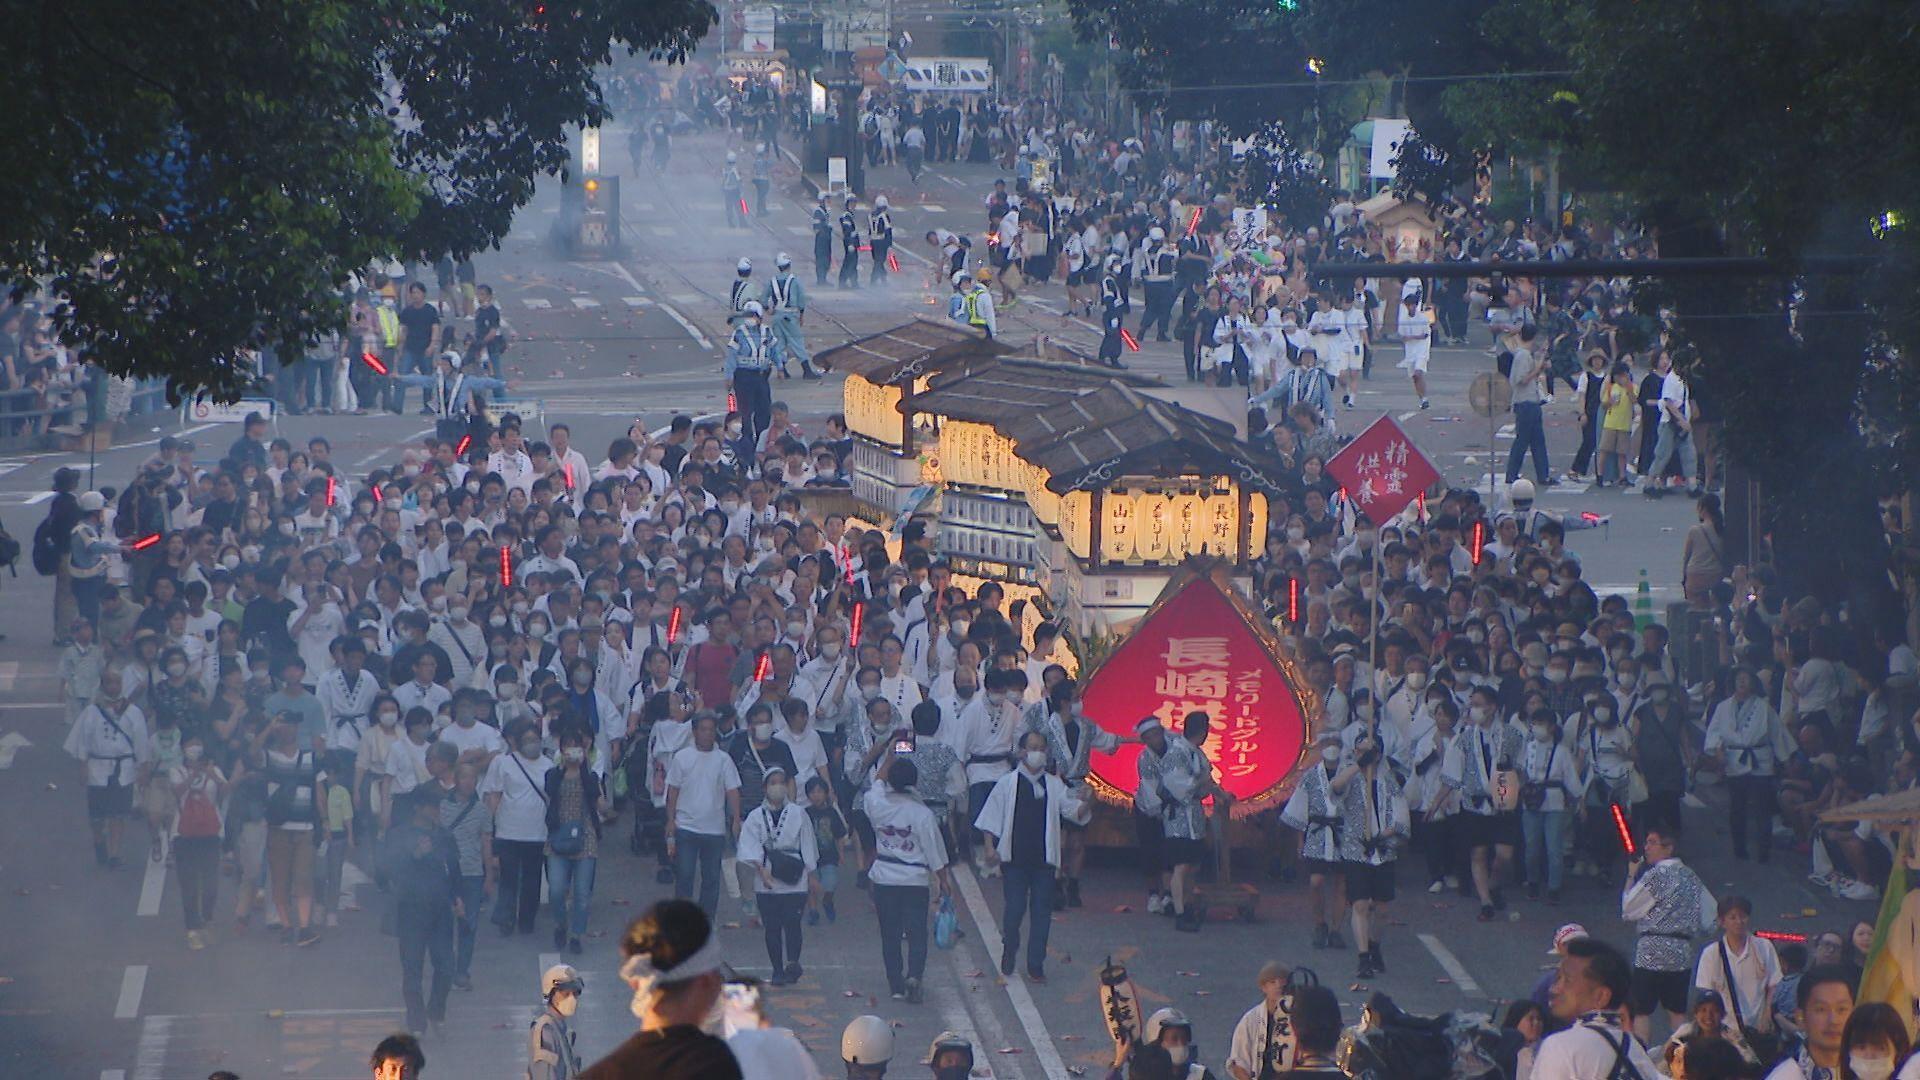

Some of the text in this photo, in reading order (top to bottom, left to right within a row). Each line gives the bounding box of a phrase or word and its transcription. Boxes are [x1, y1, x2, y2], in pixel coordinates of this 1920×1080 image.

[1355, 451, 1381, 504] 供養
[1384, 439, 1410, 495] 精霊
[1113, 503, 1128, 553] 山口家
[1213, 503, 1230, 556] 長野家
[1229, 668, 1265, 778] メモリードグループ
